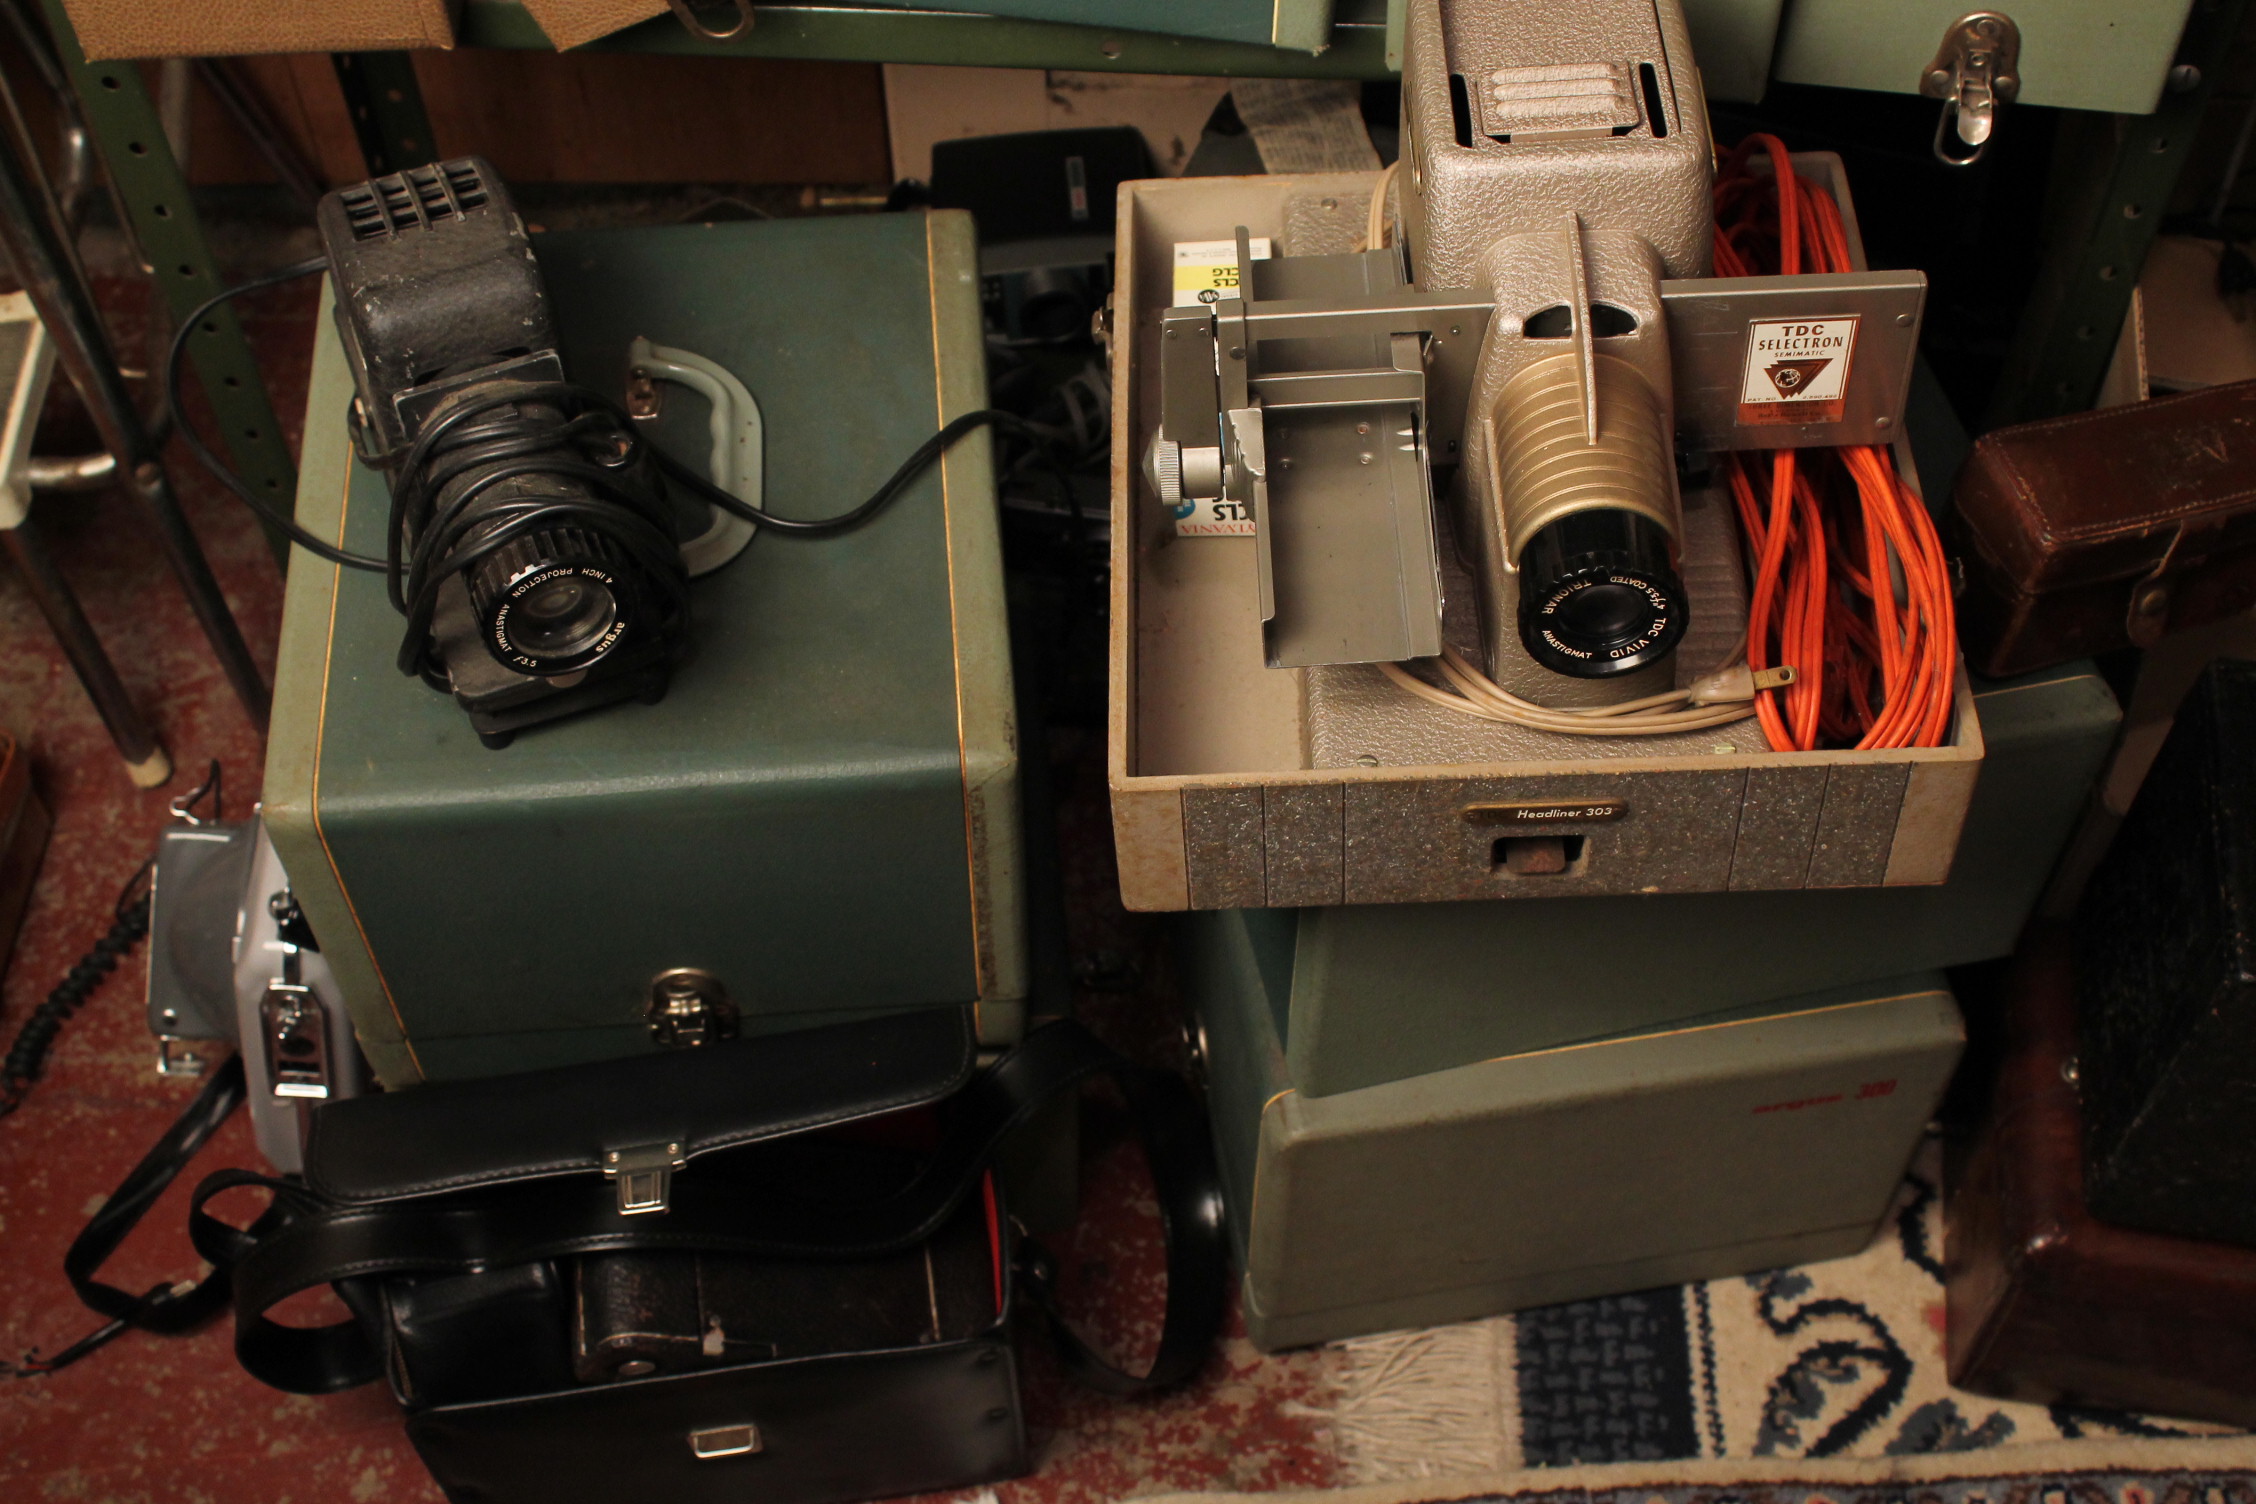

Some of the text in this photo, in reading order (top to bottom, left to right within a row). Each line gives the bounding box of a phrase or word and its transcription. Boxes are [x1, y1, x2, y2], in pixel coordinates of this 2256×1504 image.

[1213, 278, 1239, 287] CLS
[1782, 324, 1824, 336] TDC
[1758, 336, 1844, 351] SELECTRON
[1774, 350, 1825, 358] SEMIMATIC
[1180, 524, 1256, 534] YLVANIA
[582, 568, 606, 579] INCH
[512, 567, 573, 598] PROJECTION
[1609, 576, 1647, 590] COATED
[1541, 578, 1592, 615] TRIONAR
[495, 604, 512, 653] ANASTIGMAT
[595, 622, 625, 653] argus
[1541, 630, 1593, 659] ANASTIGMAT
[1610, 617, 1667, 658] TDC VIVID
[1517, 809, 1582, 819] Headliner
[1586, 807, 1613, 816] 303
